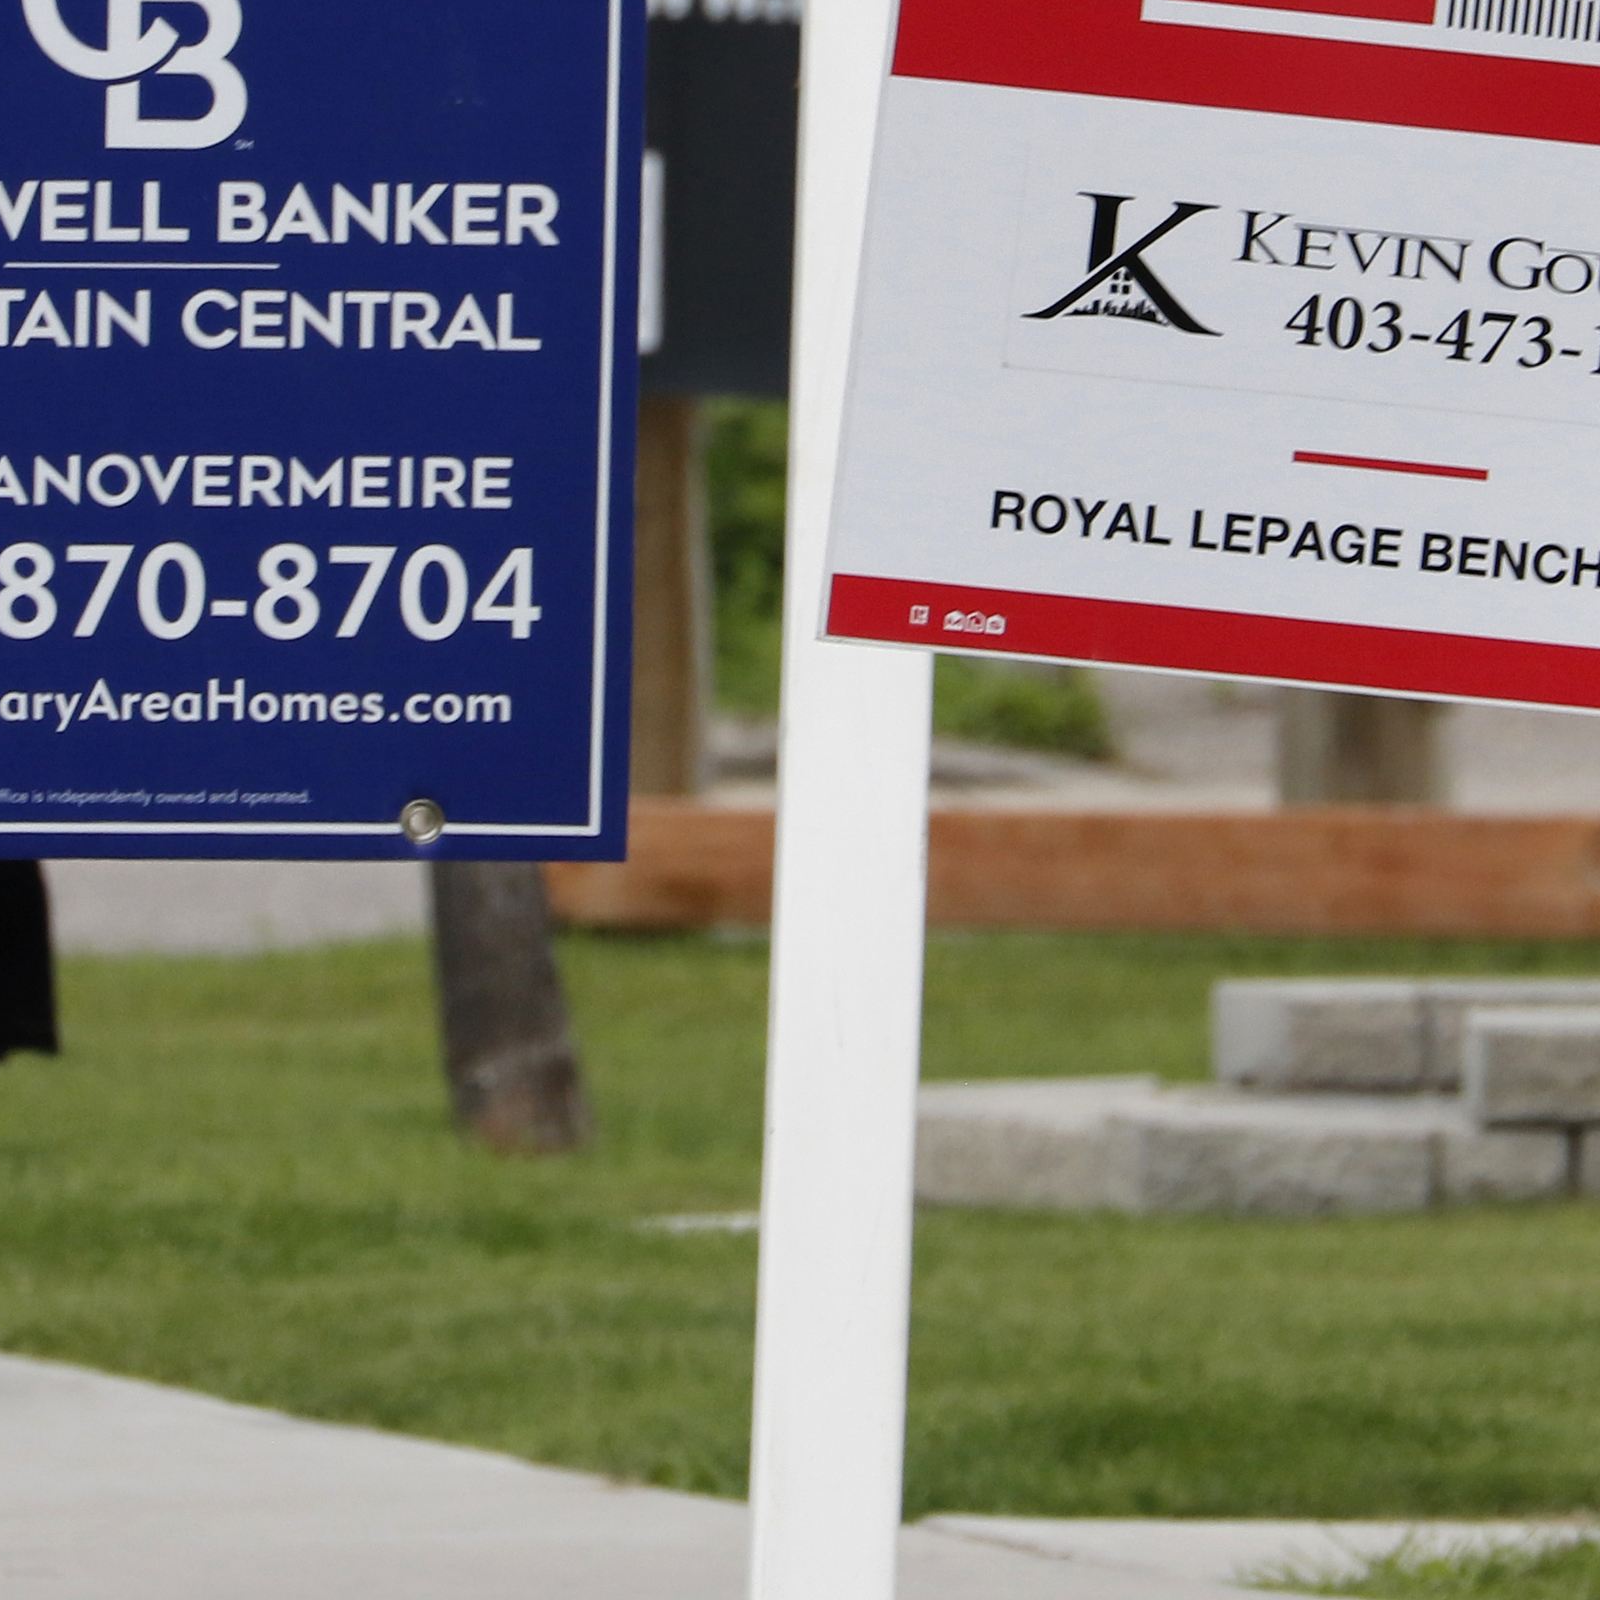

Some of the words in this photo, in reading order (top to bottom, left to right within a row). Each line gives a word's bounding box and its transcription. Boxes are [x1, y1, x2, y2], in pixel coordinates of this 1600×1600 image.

[217, 181, 559, 246] BANKER
[1234, 208, 1471, 283] KEVIN
[181, 289, 542, 351] CENTRAL
[990, 489, 1171, 547] ROYAL
[1191, 509, 1403, 568] LEPAGE
[47, 788, 152, 807] independently
[154, 789, 206, 804] owned
[208, 788, 238, 804] and
